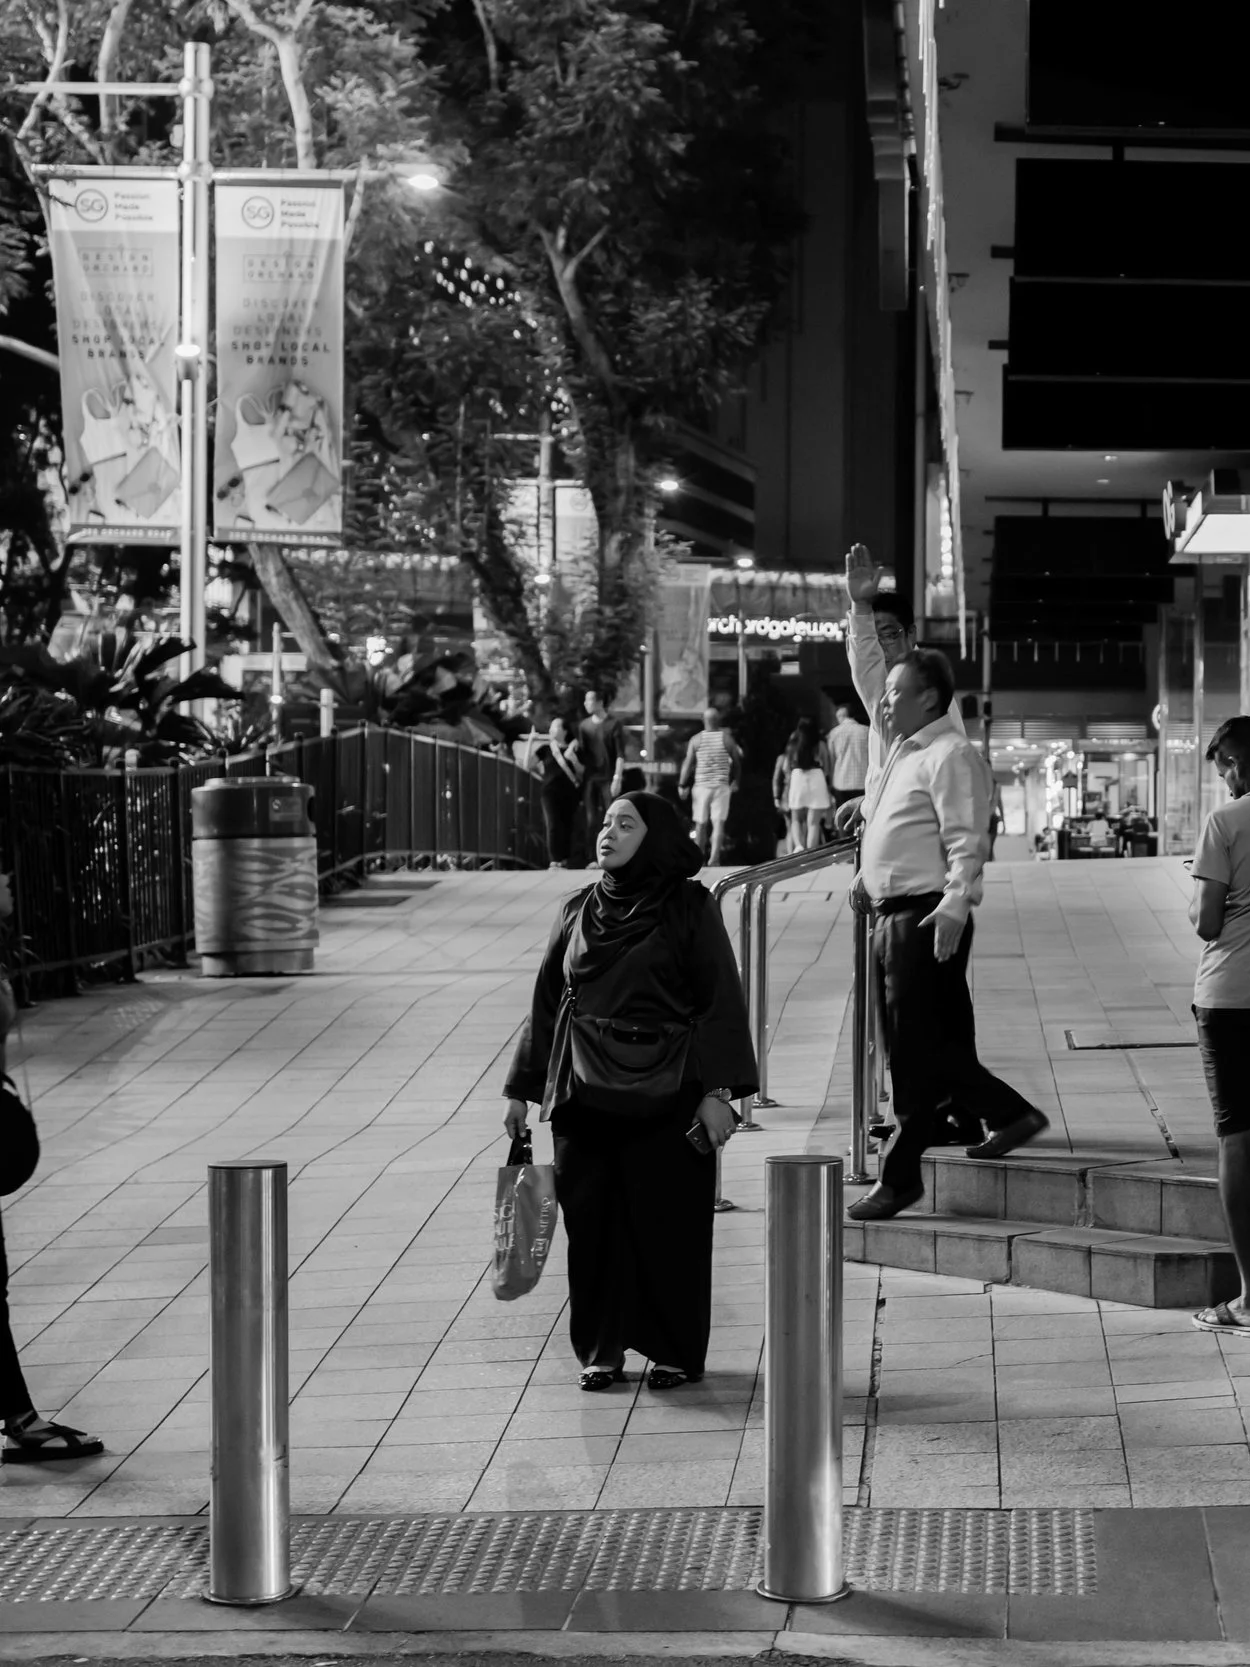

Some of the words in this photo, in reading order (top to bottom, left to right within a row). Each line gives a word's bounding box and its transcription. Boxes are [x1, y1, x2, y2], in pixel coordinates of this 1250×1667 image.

[257, 312, 302, 323] LOAL
[281, 341, 330, 353] LOCAL
[246, 355, 308, 367] BRANDS
